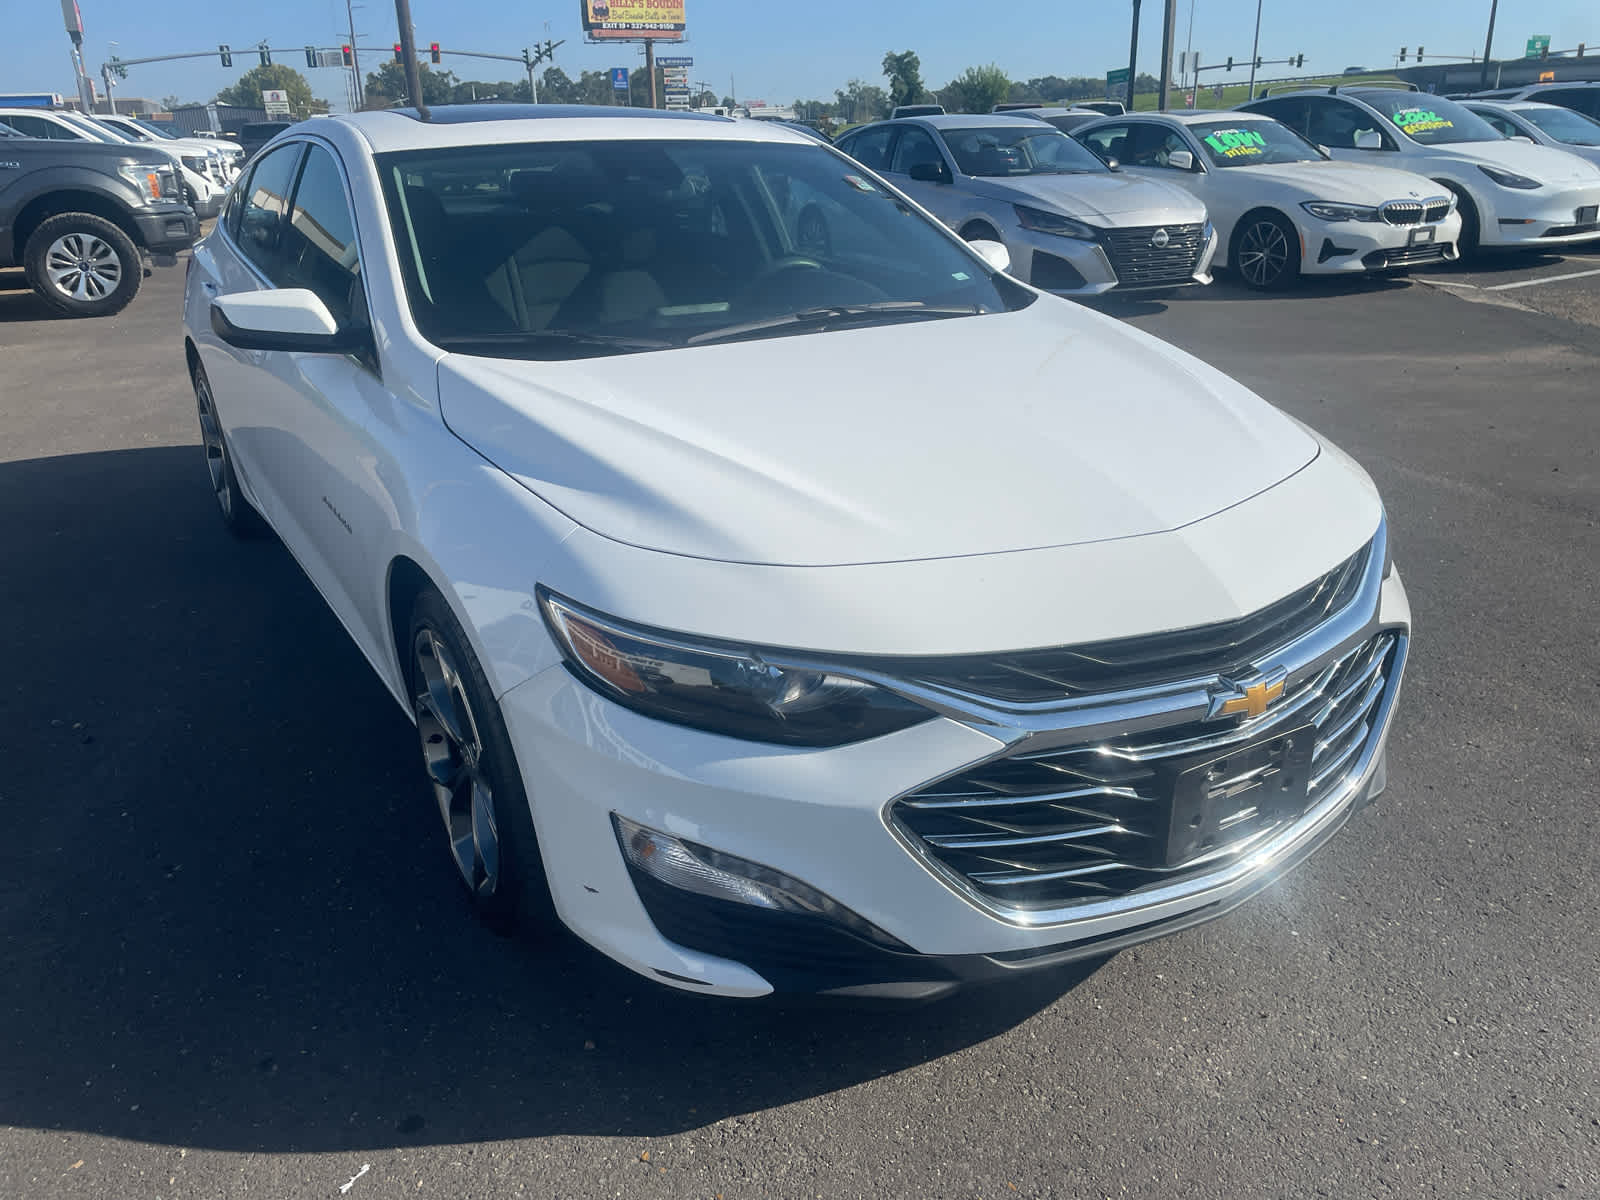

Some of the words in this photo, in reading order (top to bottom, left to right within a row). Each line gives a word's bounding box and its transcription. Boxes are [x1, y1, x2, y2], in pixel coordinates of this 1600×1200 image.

[610, 0, 644, 8] BILLY'S
[647, 0, 683, 8] BOUDIN
[1393, 111, 1443, 126] COOL
[1204, 131, 1266, 153] LOW
